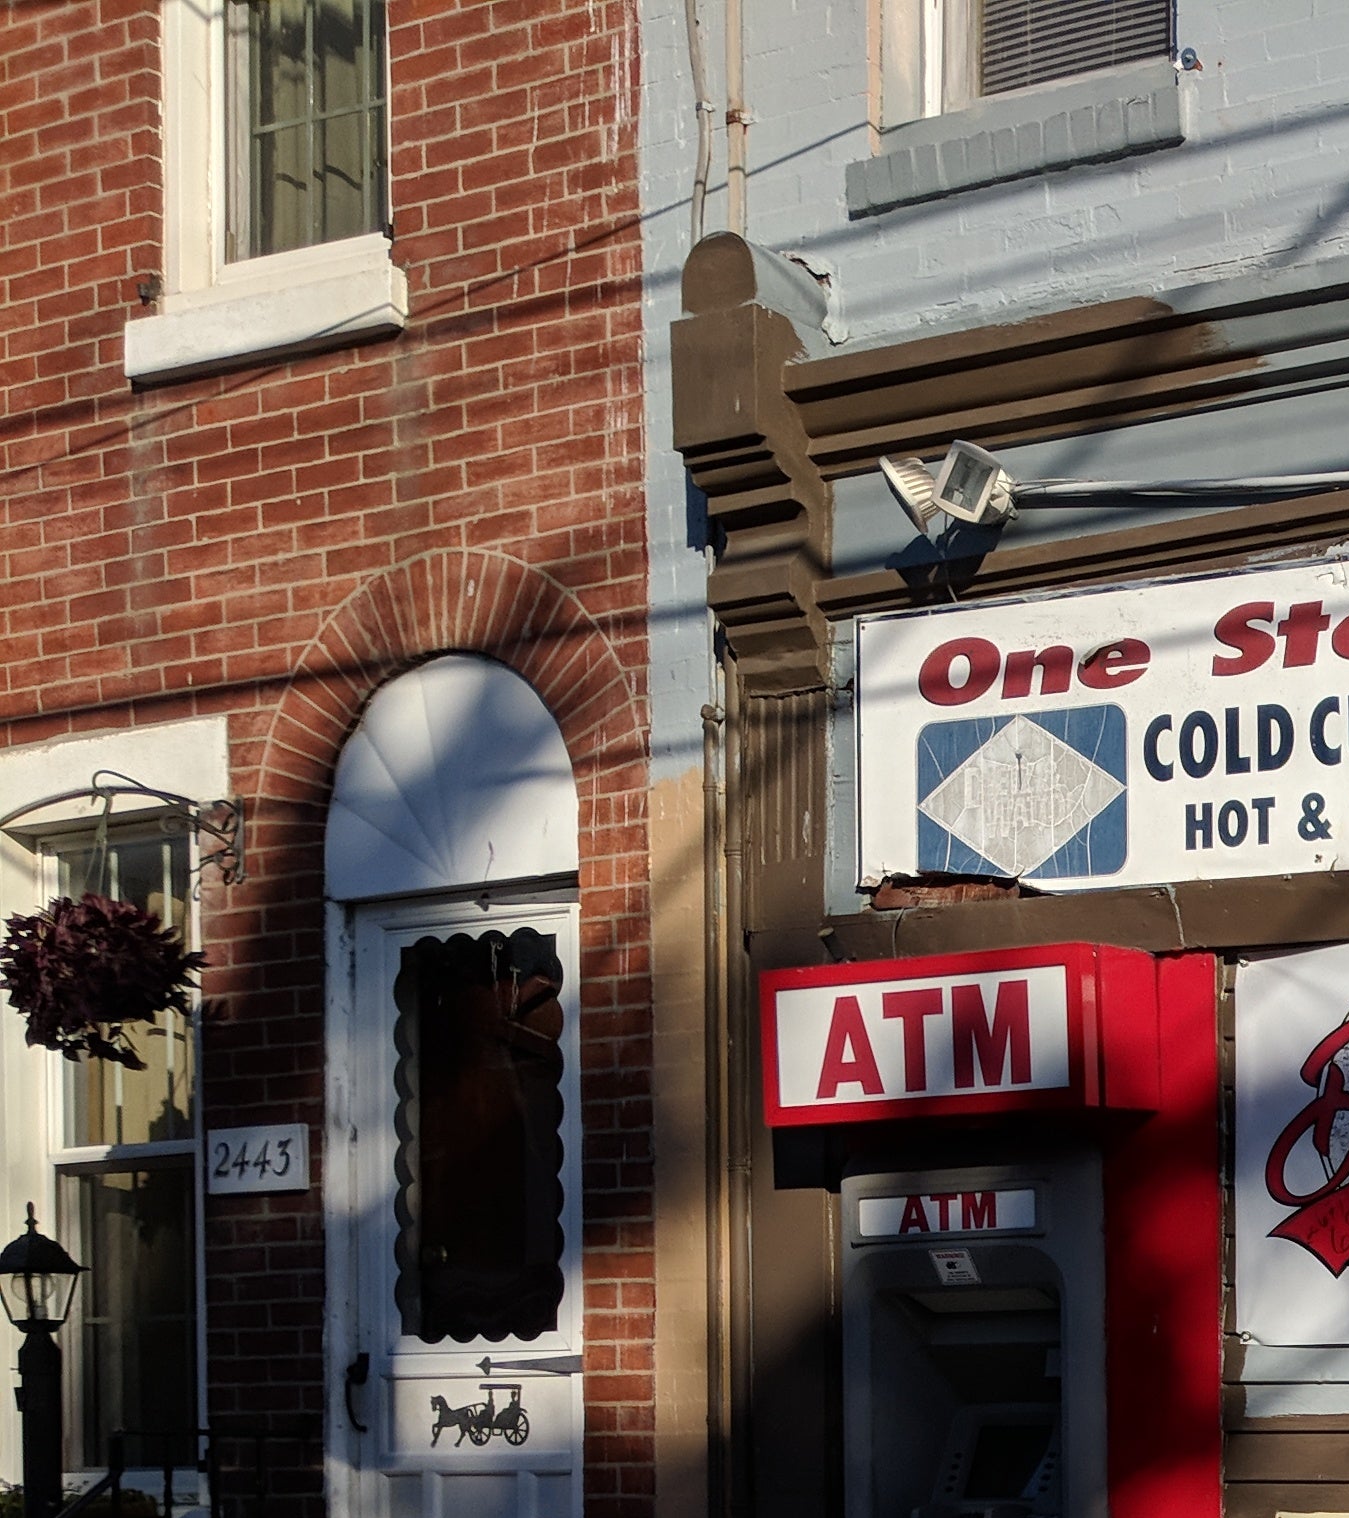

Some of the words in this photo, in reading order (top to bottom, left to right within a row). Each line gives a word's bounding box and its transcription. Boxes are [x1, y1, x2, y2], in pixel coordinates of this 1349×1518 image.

[919, 636, 1151, 705] One
[1143, 703, 1296, 782] COLD
[1185, 797, 1276, 850] HOT
[1297, 792, 1332, 841] &
[815, 979, 1031, 1101] ATM
[214, 1137, 292, 1179] 2443
[899, 1191, 998, 1235] ATM
